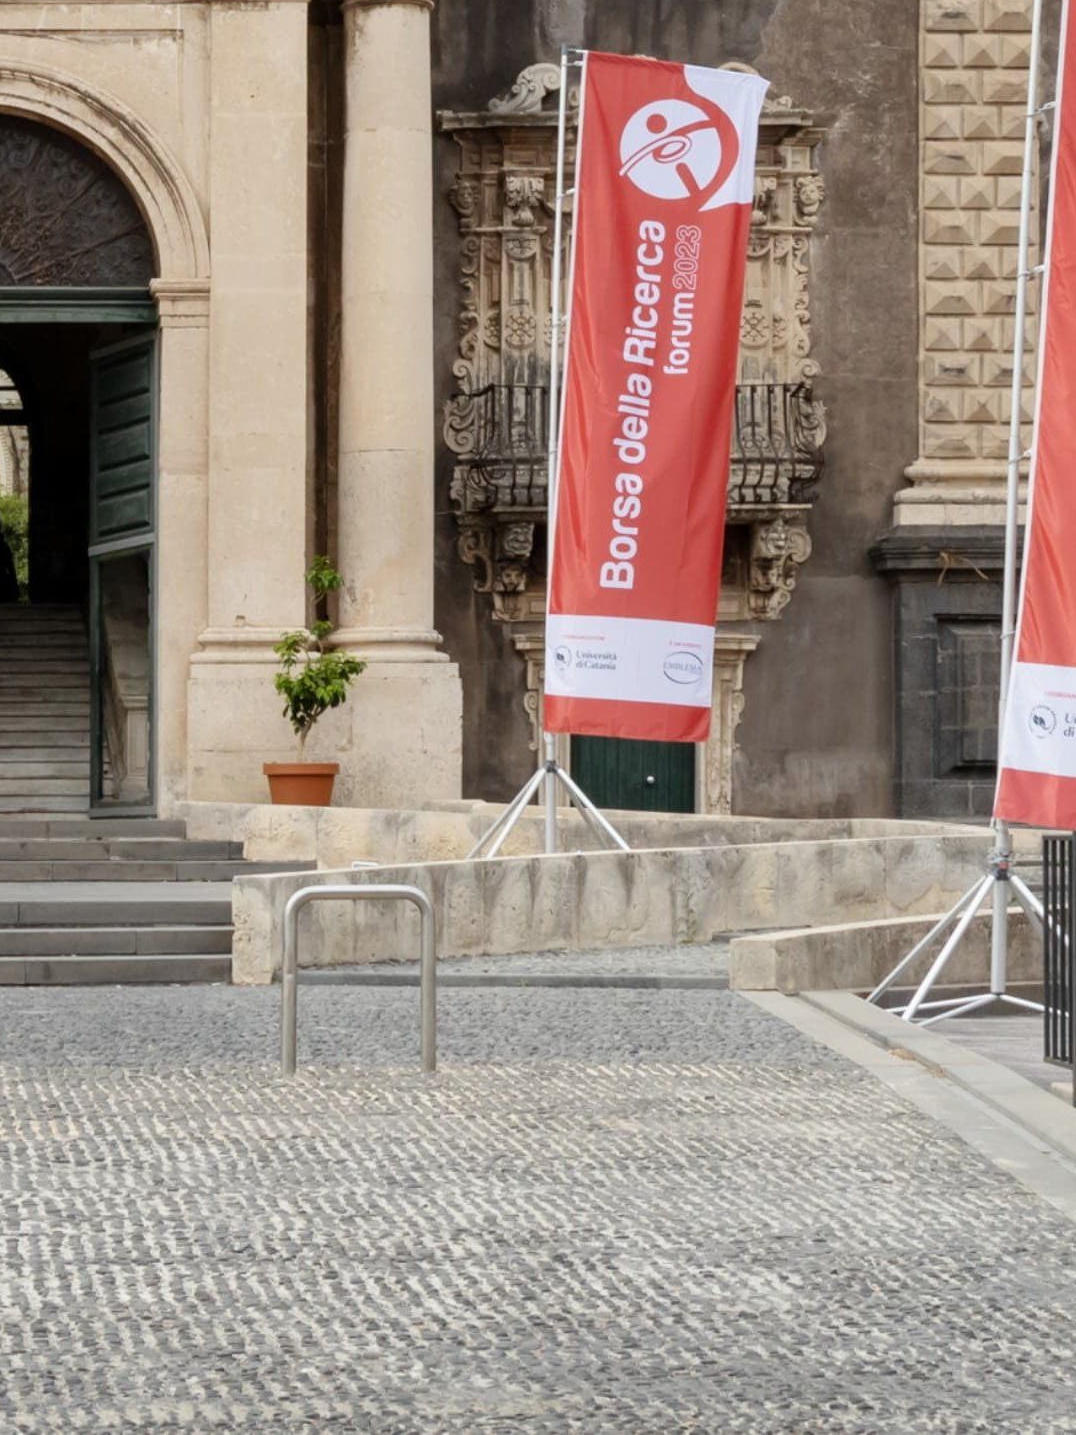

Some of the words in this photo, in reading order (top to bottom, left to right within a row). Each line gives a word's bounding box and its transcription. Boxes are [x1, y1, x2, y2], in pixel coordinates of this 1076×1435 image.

[623, 219, 667, 367] Ricerca
[672, 224, 702, 291] 2023
[662, 292, 695, 375] forum
[612, 372, 653, 465] della
[599, 472, 644, 590] Borsa
